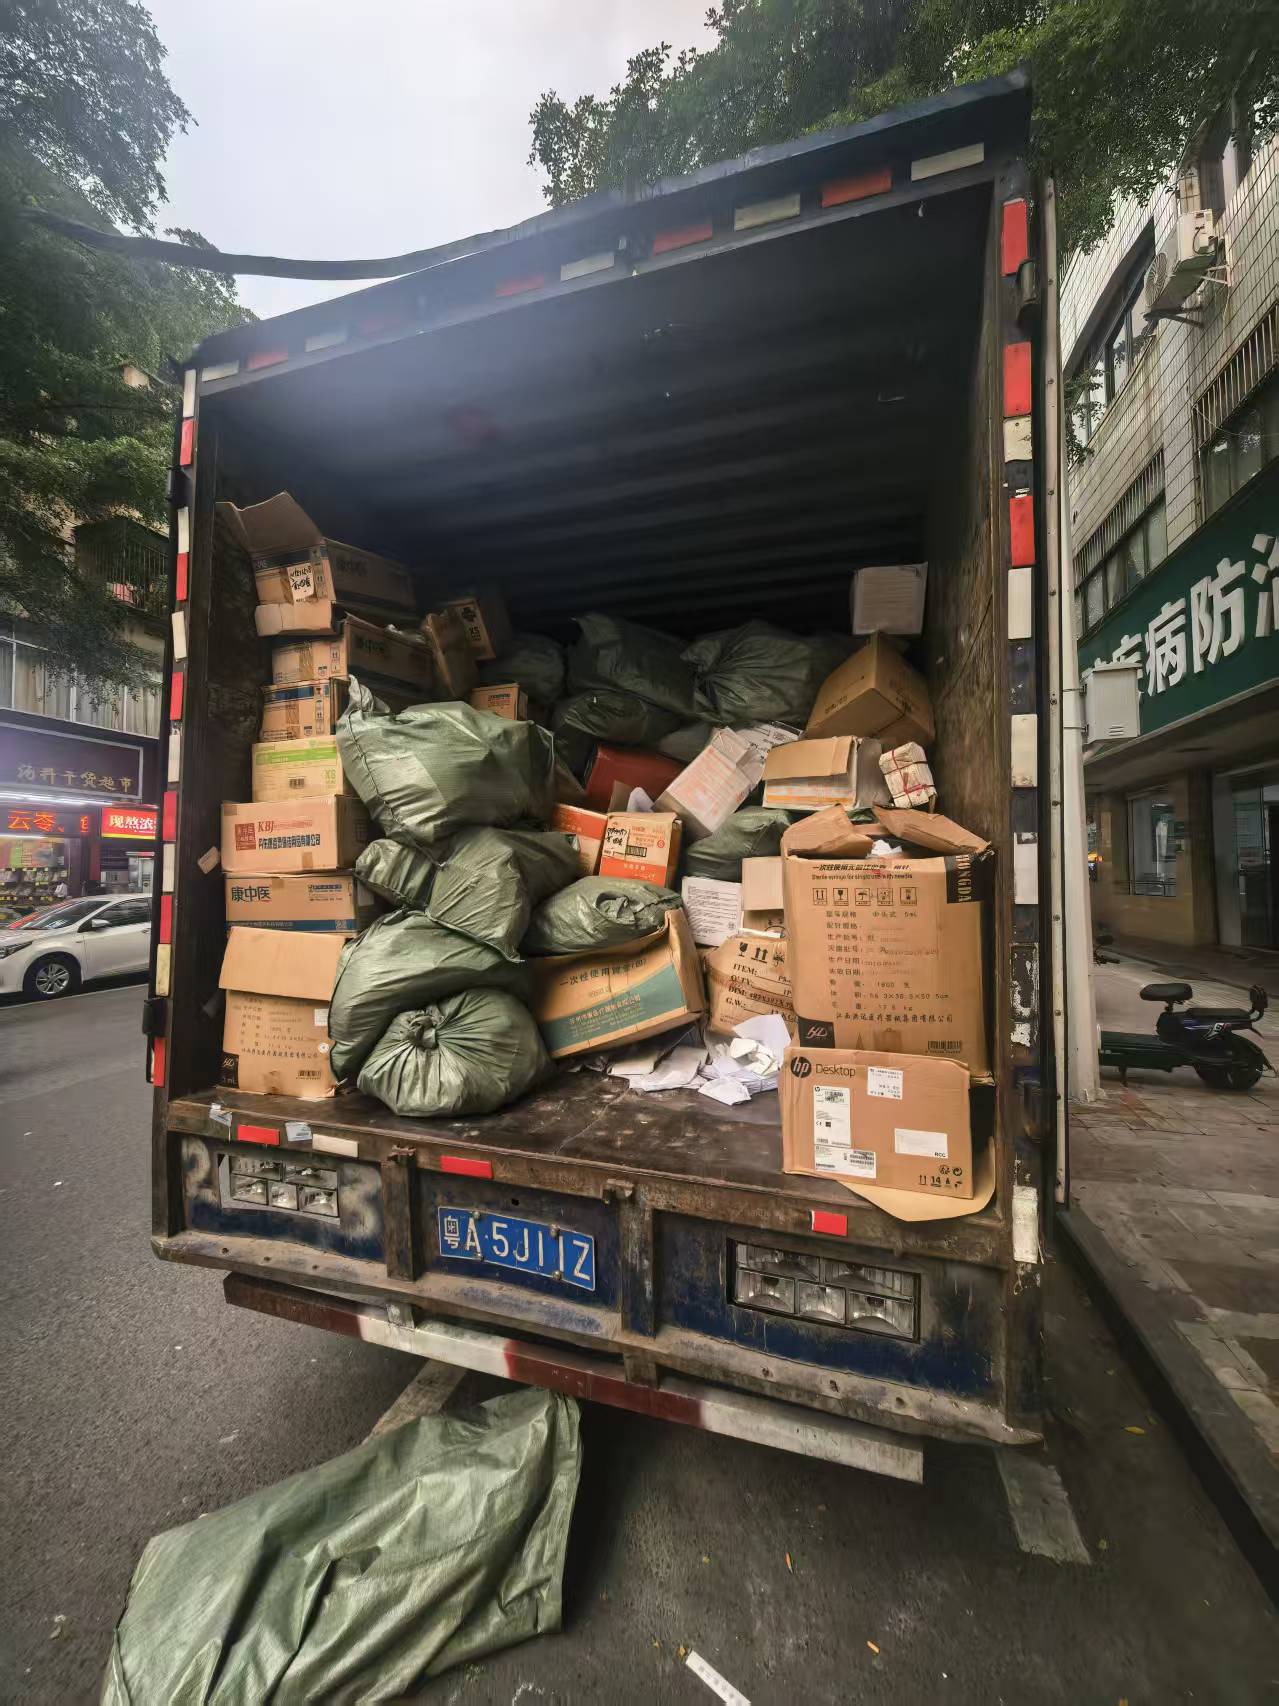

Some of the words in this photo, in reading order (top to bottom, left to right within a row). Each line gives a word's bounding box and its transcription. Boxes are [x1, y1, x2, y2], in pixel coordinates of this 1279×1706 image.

[231, 884, 271, 903] 康中医
[791, 1057, 811, 1078] hp
[815, 1064, 857, 1078] Desktop
